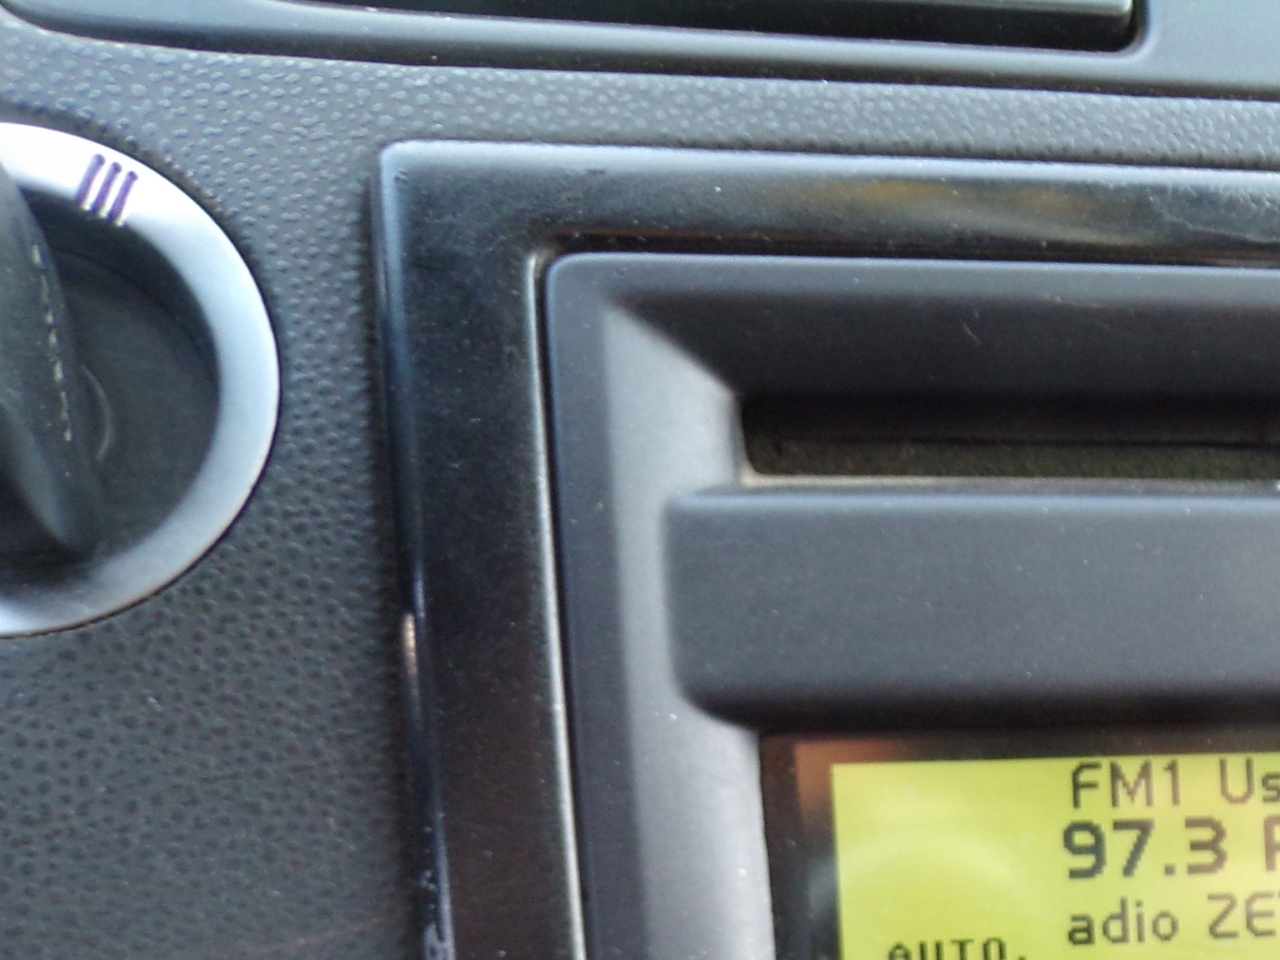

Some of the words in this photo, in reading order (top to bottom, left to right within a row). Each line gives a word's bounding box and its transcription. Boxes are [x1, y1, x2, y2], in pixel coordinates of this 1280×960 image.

[1071, 758, 1181, 809] FM1
[1062, 815, 1229, 879] 97.3
[1068, 898, 1179, 946] adio
